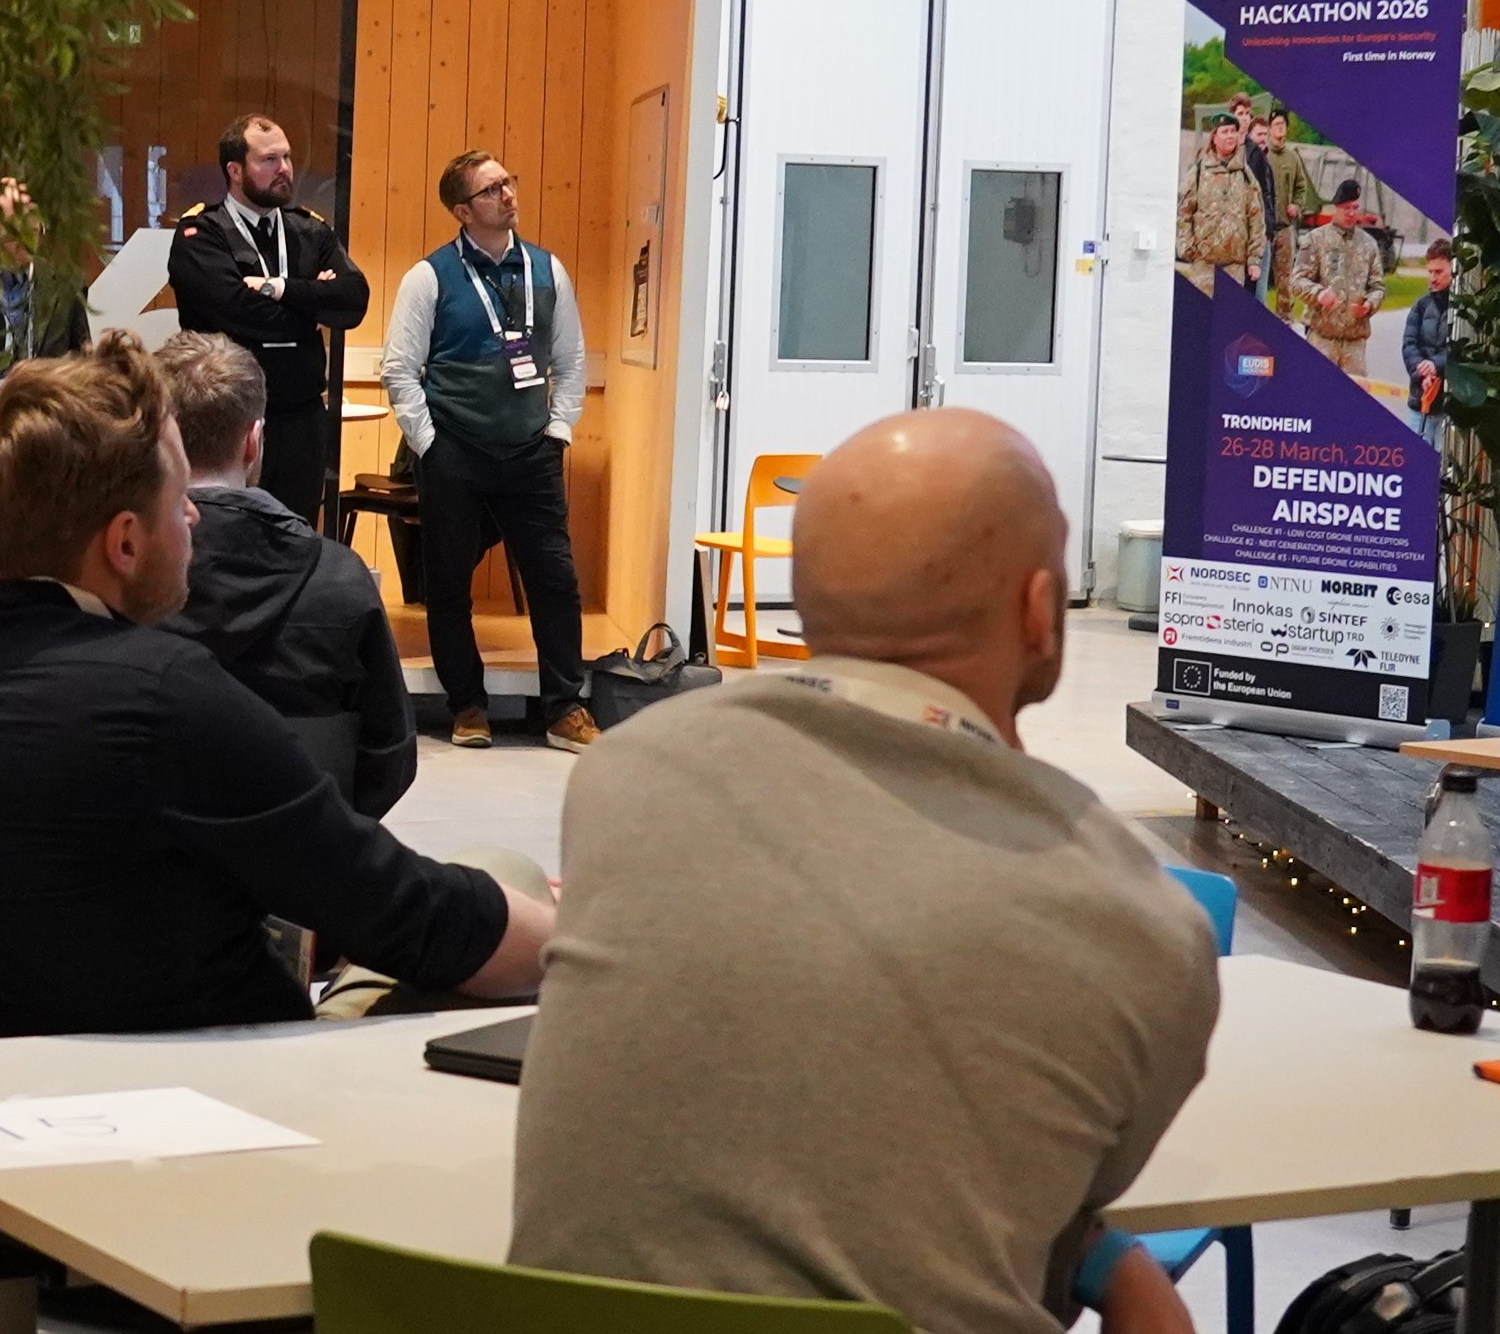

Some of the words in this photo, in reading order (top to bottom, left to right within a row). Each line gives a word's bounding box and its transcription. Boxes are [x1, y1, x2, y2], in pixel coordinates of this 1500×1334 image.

[1240, 1, 1371, 25] HACKATHON
[1243, 38, 1289, 47] Unleashing
[1399, 32, 1436, 43] Security
[1343, 52, 1362, 62] First
[1365, 51, 1385, 61] time
[1388, 50, 1396, 60] in
[1399, 50, 1436, 61] Norway
[1222, 414, 1311, 433] TRONDHEIM
[1221, 437, 1274, 458] 26-28
[1280, 440, 1349, 465] March,
[1353, 446, 1404, 467] 2026
[1253, 465, 1402, 498] DEFENDING
[1272, 500, 1401, 531] AIRSPACE
[1232, 524, 1272, 535] CHALLENGE
[1306, 530, 1325, 539] COST
[1326, 532, 1352, 542] DRONE
[1354, 535, 1409, 547] INTERCEPTORS
[1204, 534, 1244, 545] CHALLENGE
[1278, 541, 1325, 552] GENERATION
[1326, 545, 1351, 554] DRONE
[1353, 548, 1395, 558] DETECTION
[1396, 552, 1425, 561] SYSTEM
[1235, 550, 1275, 561] CHALLENGE
[1292, 555, 1320, 564] FUTURE
[1322, 557, 1348, 567] DRONE
[1349, 560, 1397, 572] CAPABILITIES
[1191, 568, 1251, 583] NORDSEC
[1270, 577, 1312, 593] NTNU
[1321, 580, 1378, 598] NORBIT
[1165, 591, 1181, 605] FFI
[1404, 593, 1430, 605] esa
[1233, 598, 1293, 617] Innokas
[1164, 612, 1204, 627] sopra
[1224, 618, 1264, 634] steria
[1319, 612, 1367, 626] SINTEF
[1288, 625, 1344, 646] startup
[1347, 632, 1364, 642] TRD
[1380, 651, 1420, 665] TELEDYNE
[1380, 662, 1396, 672] FLIR
[1214, 668, 1243, 681] Funded
[1245, 672, 1256, 683] by
[1214, 682, 1226, 690] the
[1228, 683, 1265, 696] European
[1268, 689, 1292, 699] Union
